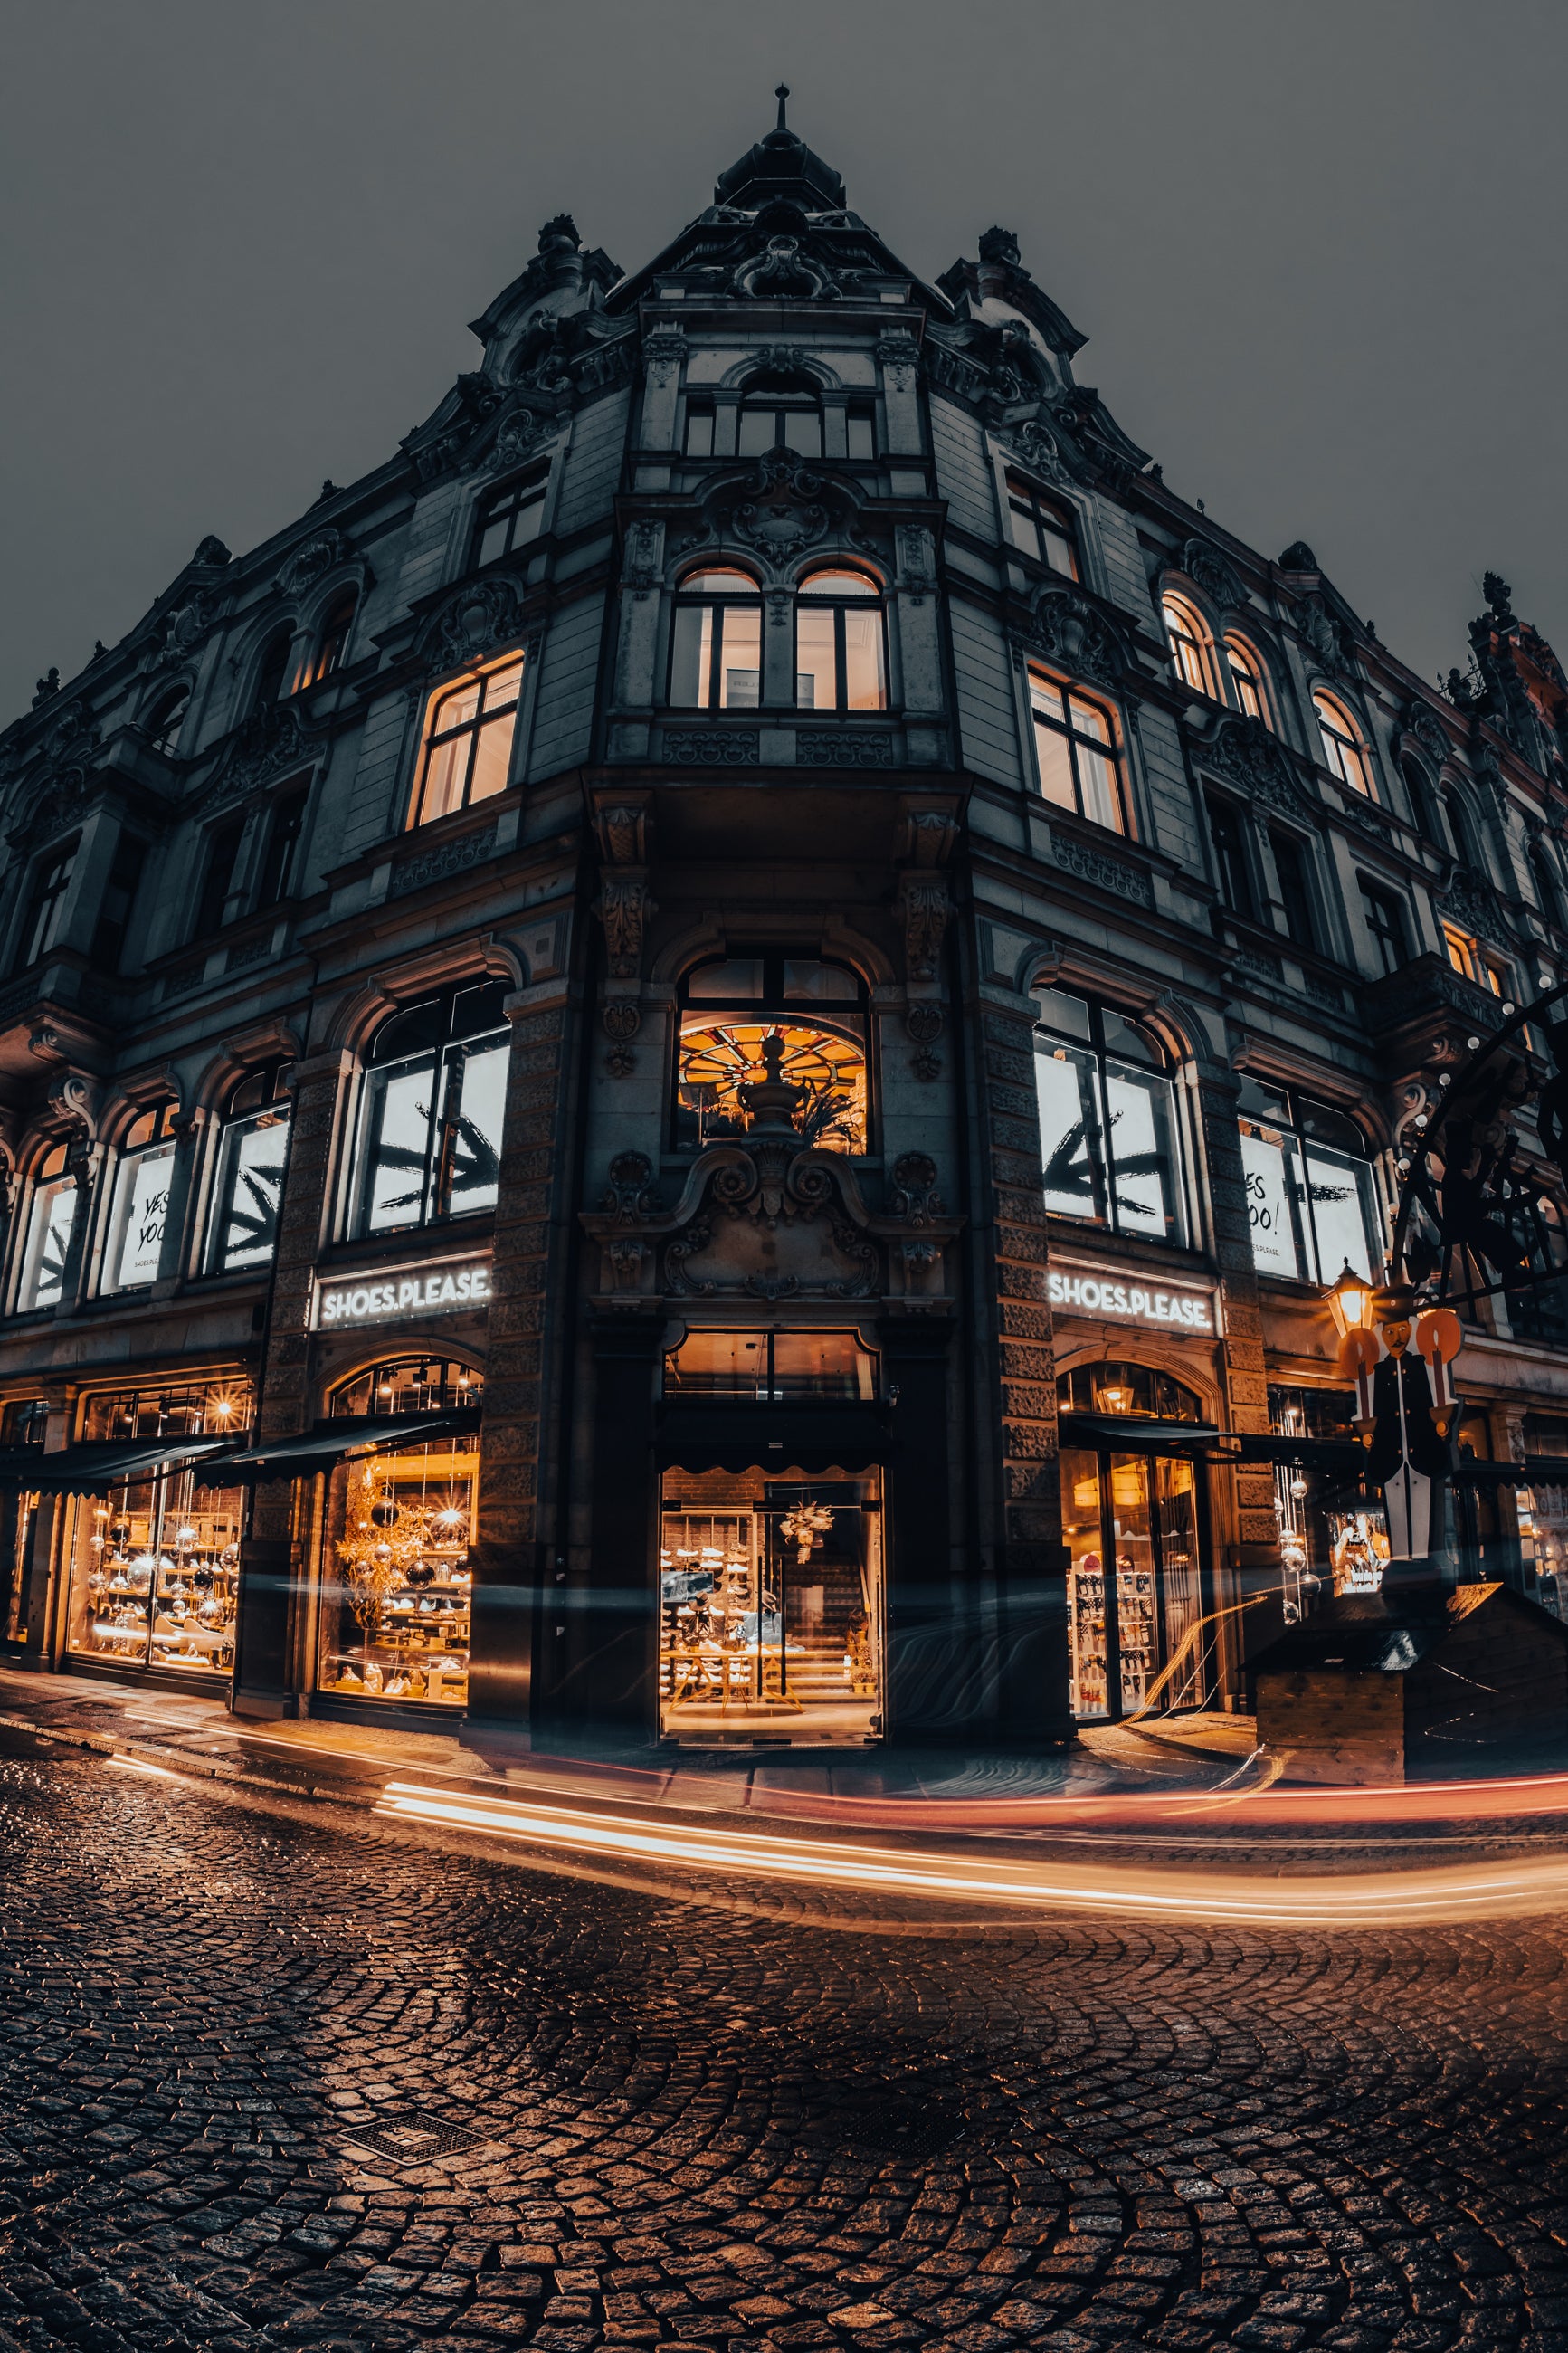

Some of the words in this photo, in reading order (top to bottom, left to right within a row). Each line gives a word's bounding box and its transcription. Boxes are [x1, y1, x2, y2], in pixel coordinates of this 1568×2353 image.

[1246, 1172, 1266, 1200] ES
[1249, 1201, 1280, 1236] OO!
[323, 1270, 491, 1320] SHOES.PLEASE.
[1049, 1274, 1211, 1329] SHOES.PLEASE.
